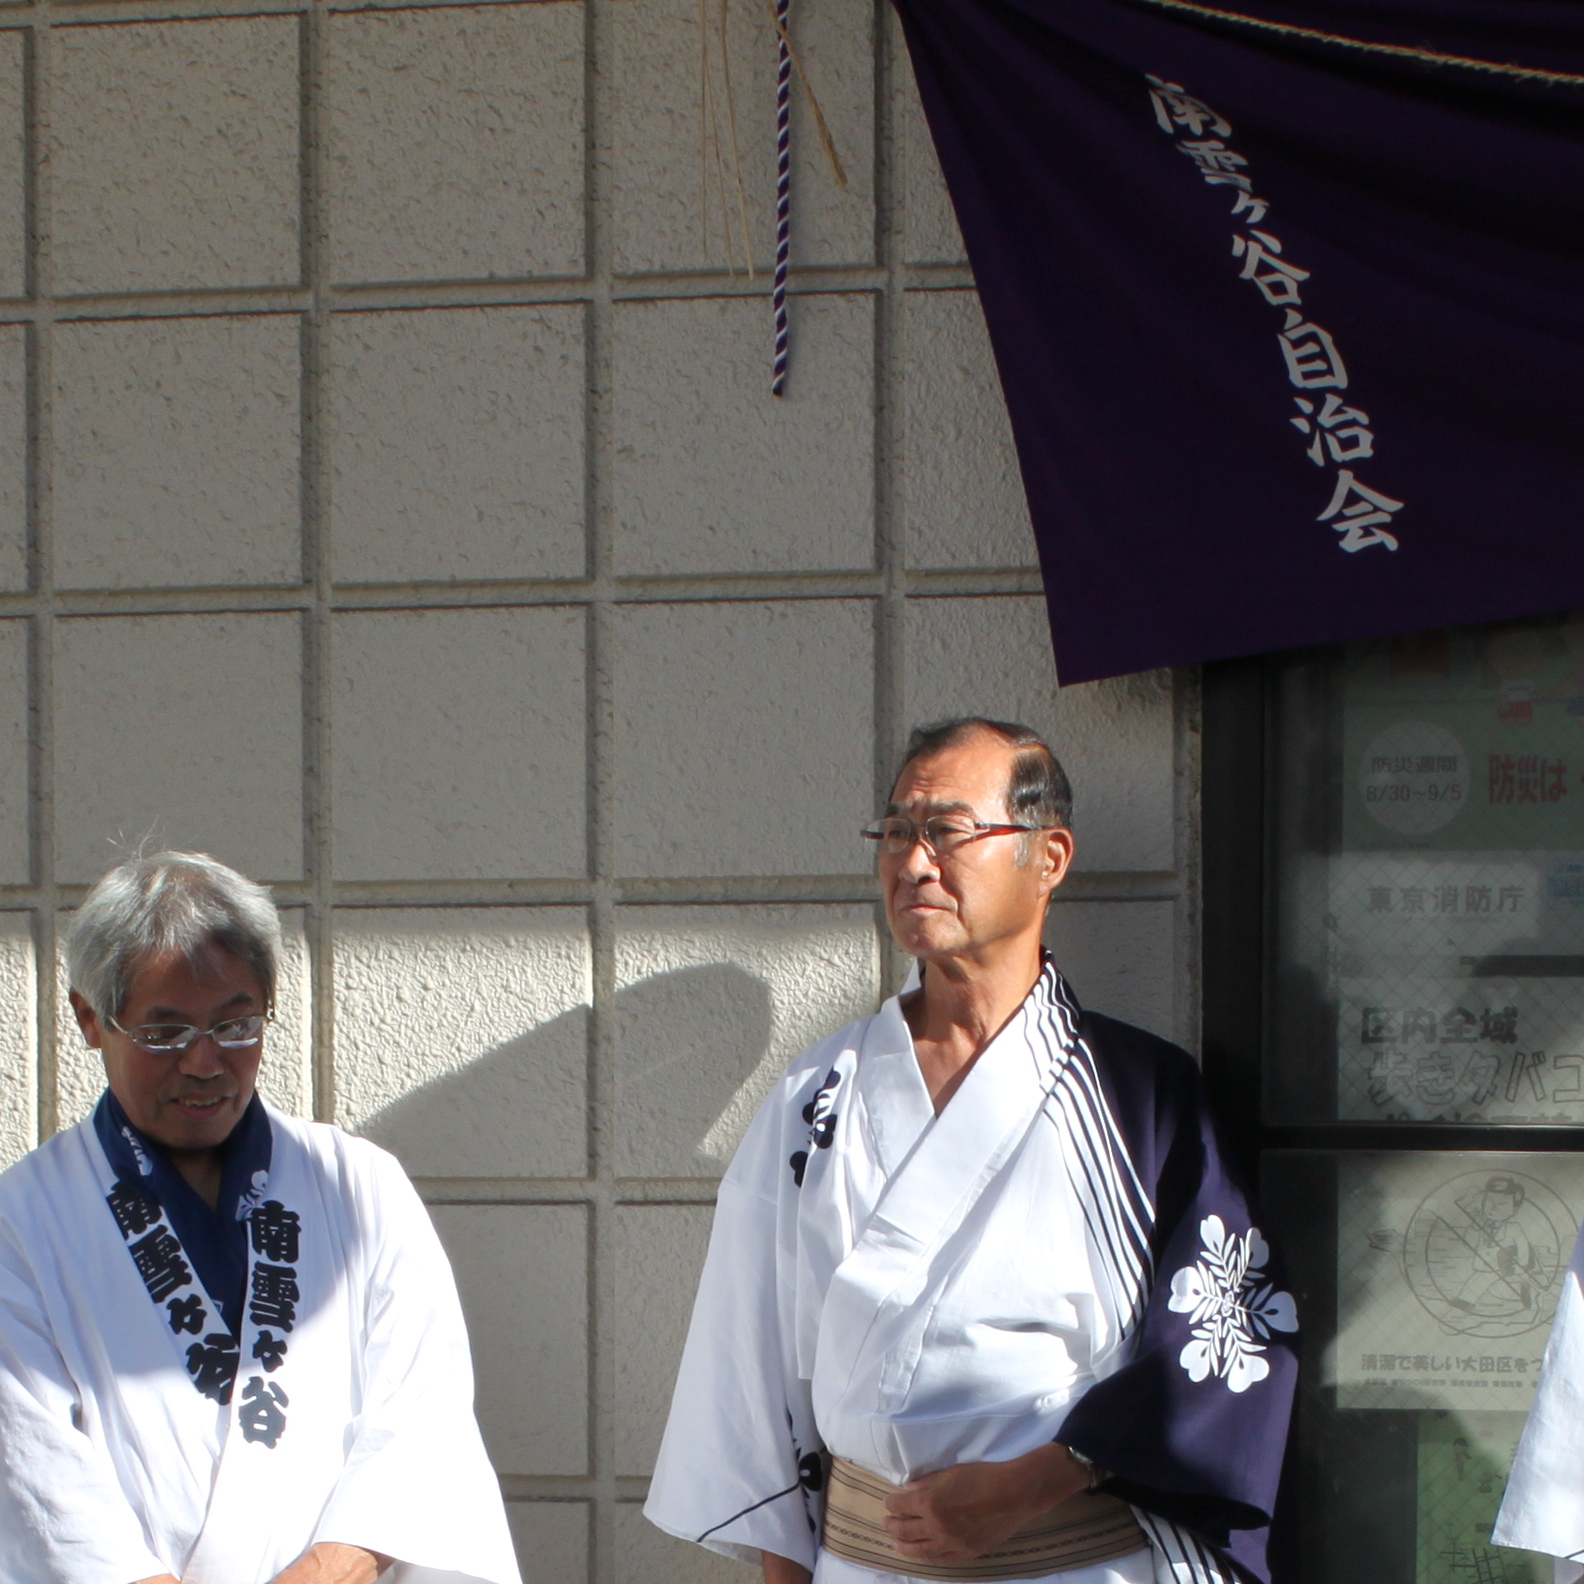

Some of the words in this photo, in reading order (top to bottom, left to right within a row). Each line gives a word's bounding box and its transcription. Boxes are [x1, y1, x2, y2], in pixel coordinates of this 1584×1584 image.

[1371, 755, 1458, 775] 防災週間
[1489, 753, 1567, 804] 防災は
[1366, 884, 1526, 915] 東京消防庁
[1361, 1006, 1520, 1045] 区内全域
